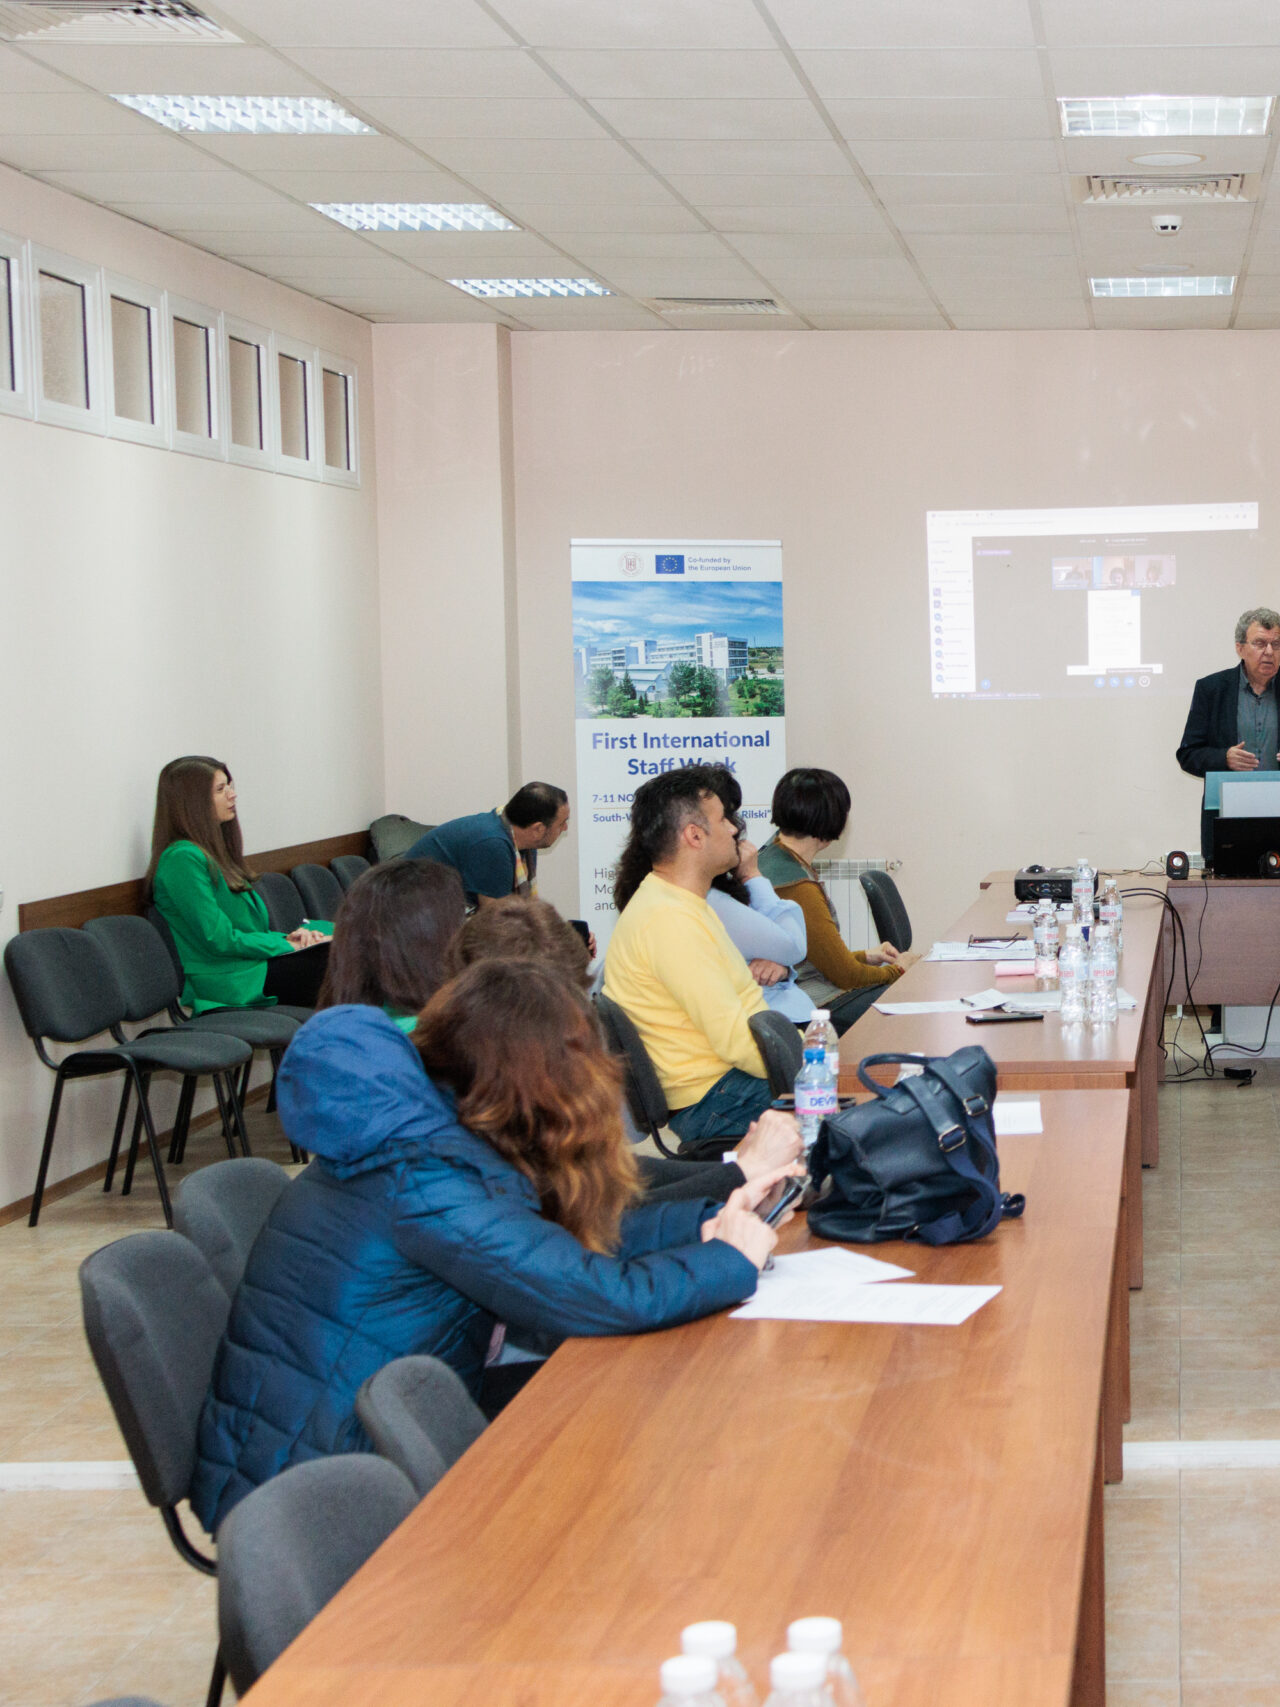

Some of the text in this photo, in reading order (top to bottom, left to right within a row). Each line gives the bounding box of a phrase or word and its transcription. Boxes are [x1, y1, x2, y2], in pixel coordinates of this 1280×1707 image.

[592, 730, 770, 749] First International
[627, 757, 675, 775] Staff
[592, 793, 615, 803] 7-11
